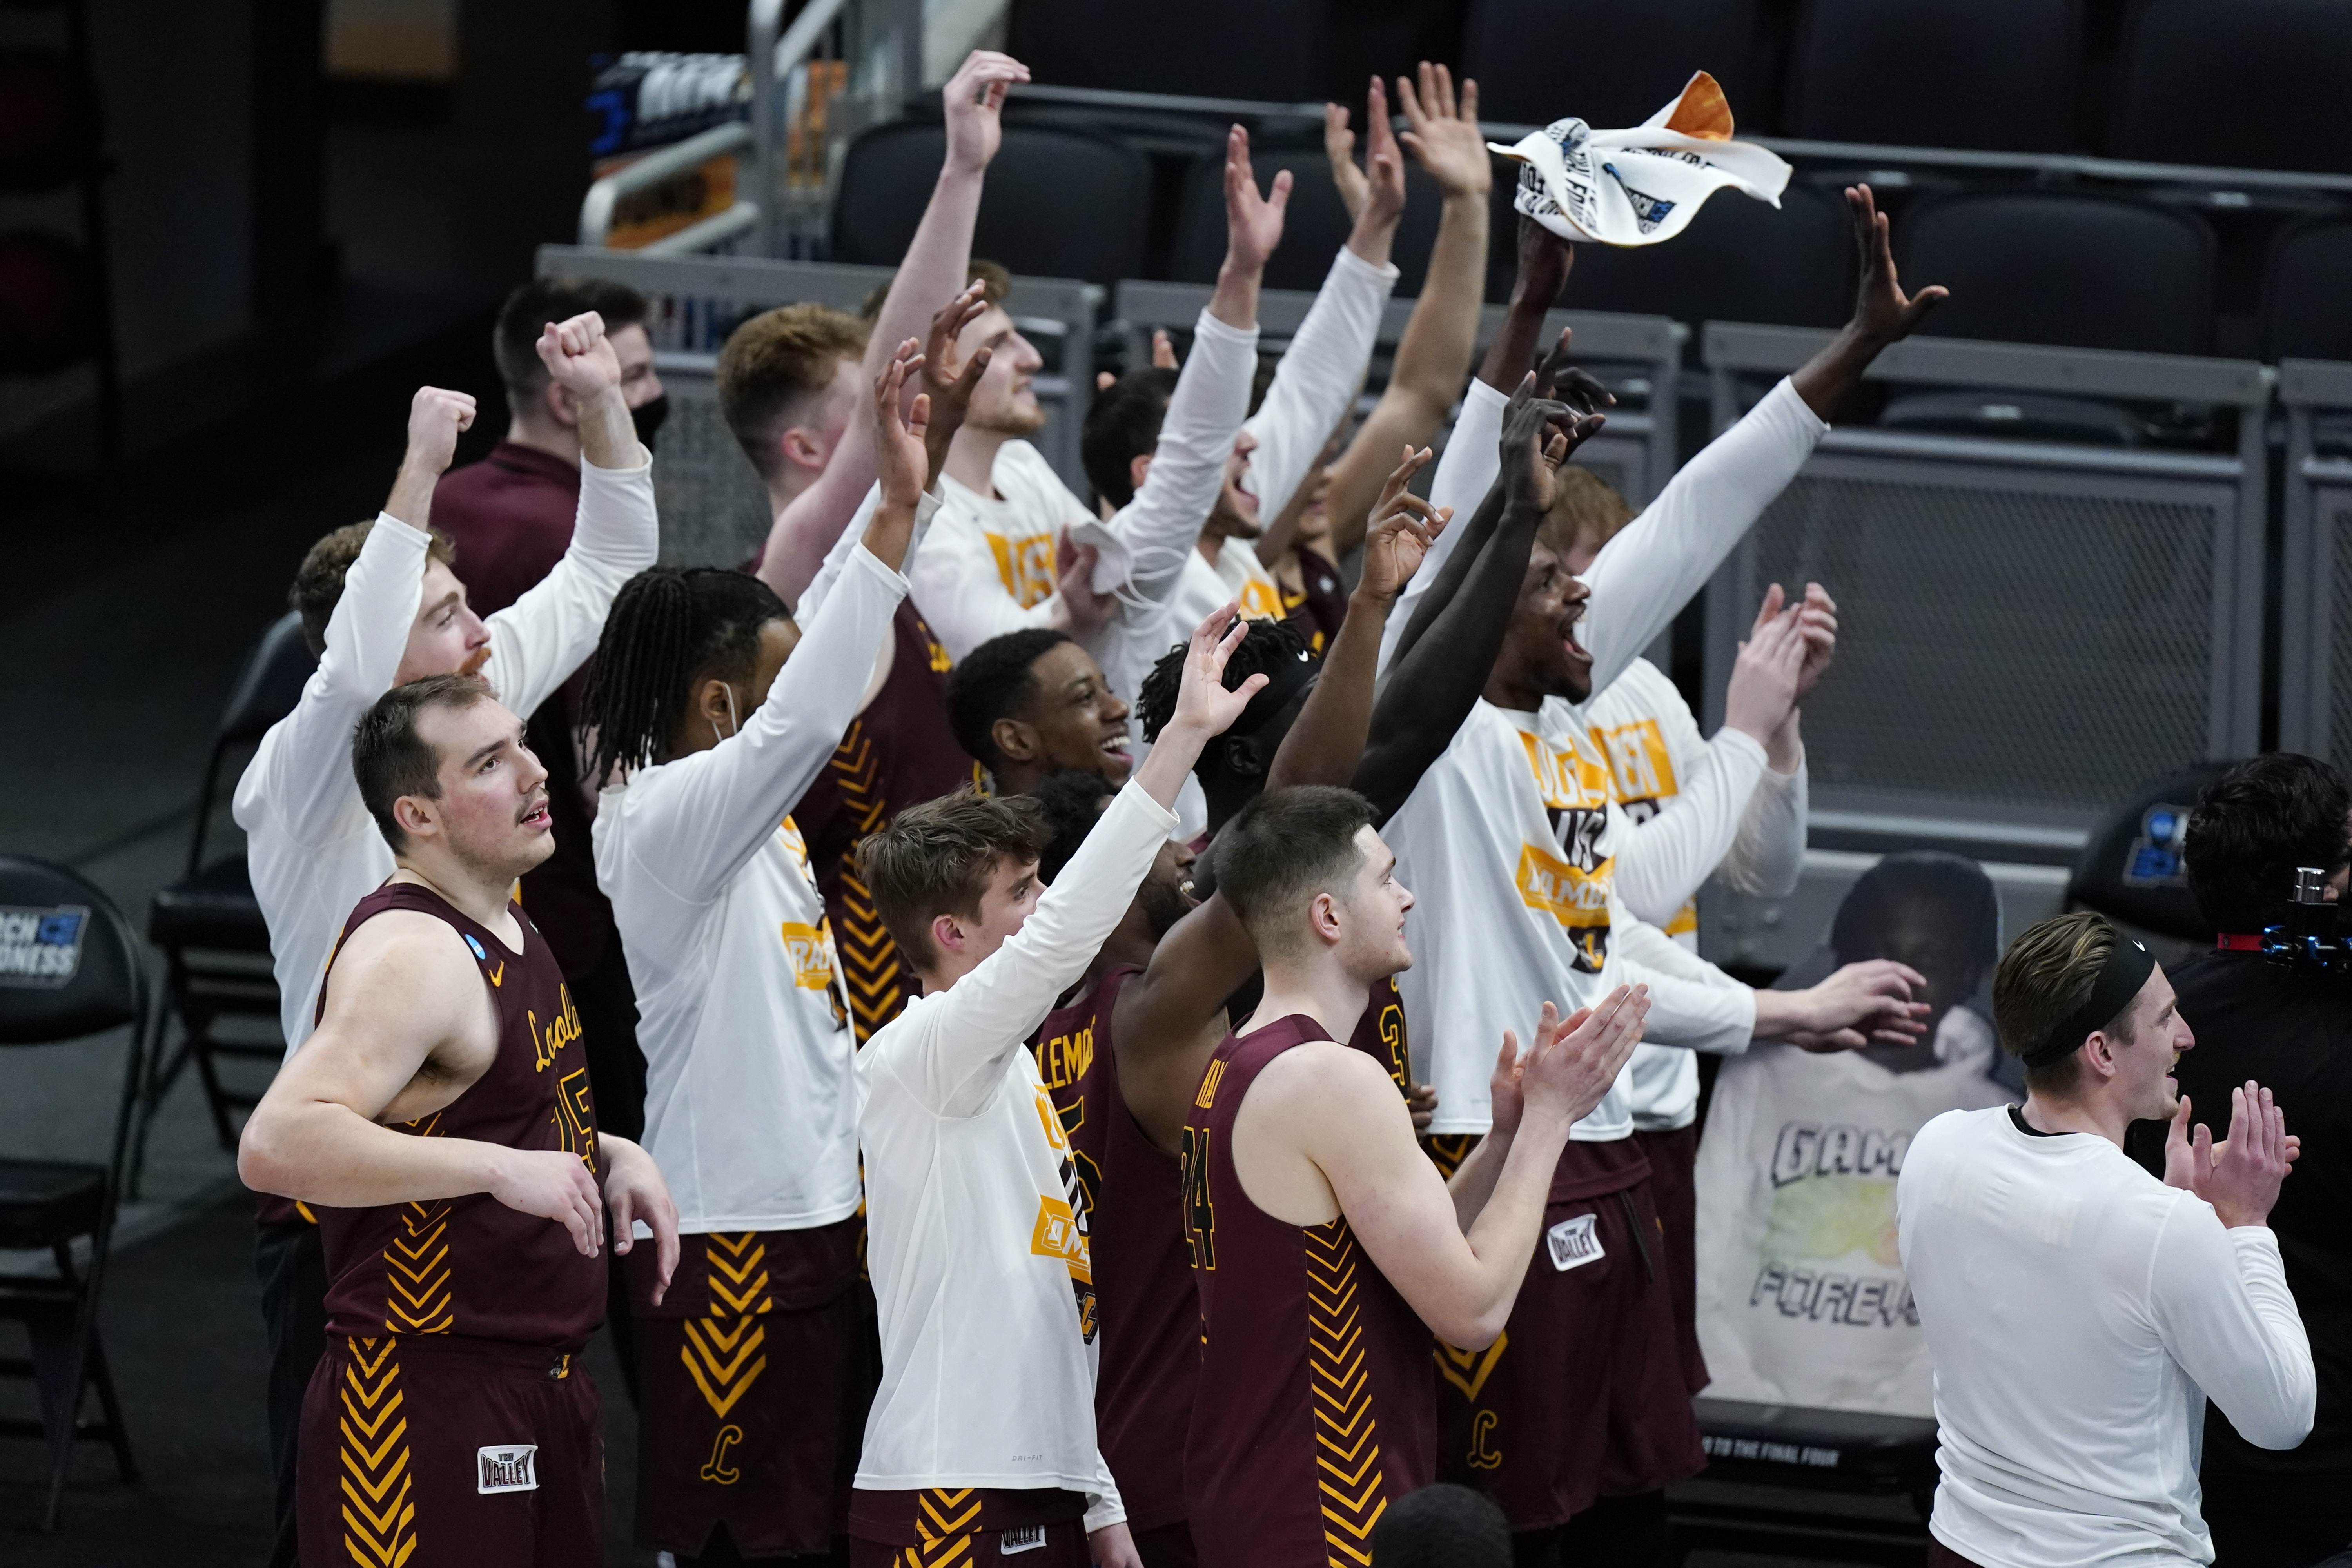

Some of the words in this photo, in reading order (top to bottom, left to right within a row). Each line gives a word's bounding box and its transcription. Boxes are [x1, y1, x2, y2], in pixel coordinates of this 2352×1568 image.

[1181, 1125, 1216, 1270] 24
[481, 1450, 532, 1488] VALLEY
[499, 1453, 514, 1461] THE
[700, 1424, 743, 1485] L
